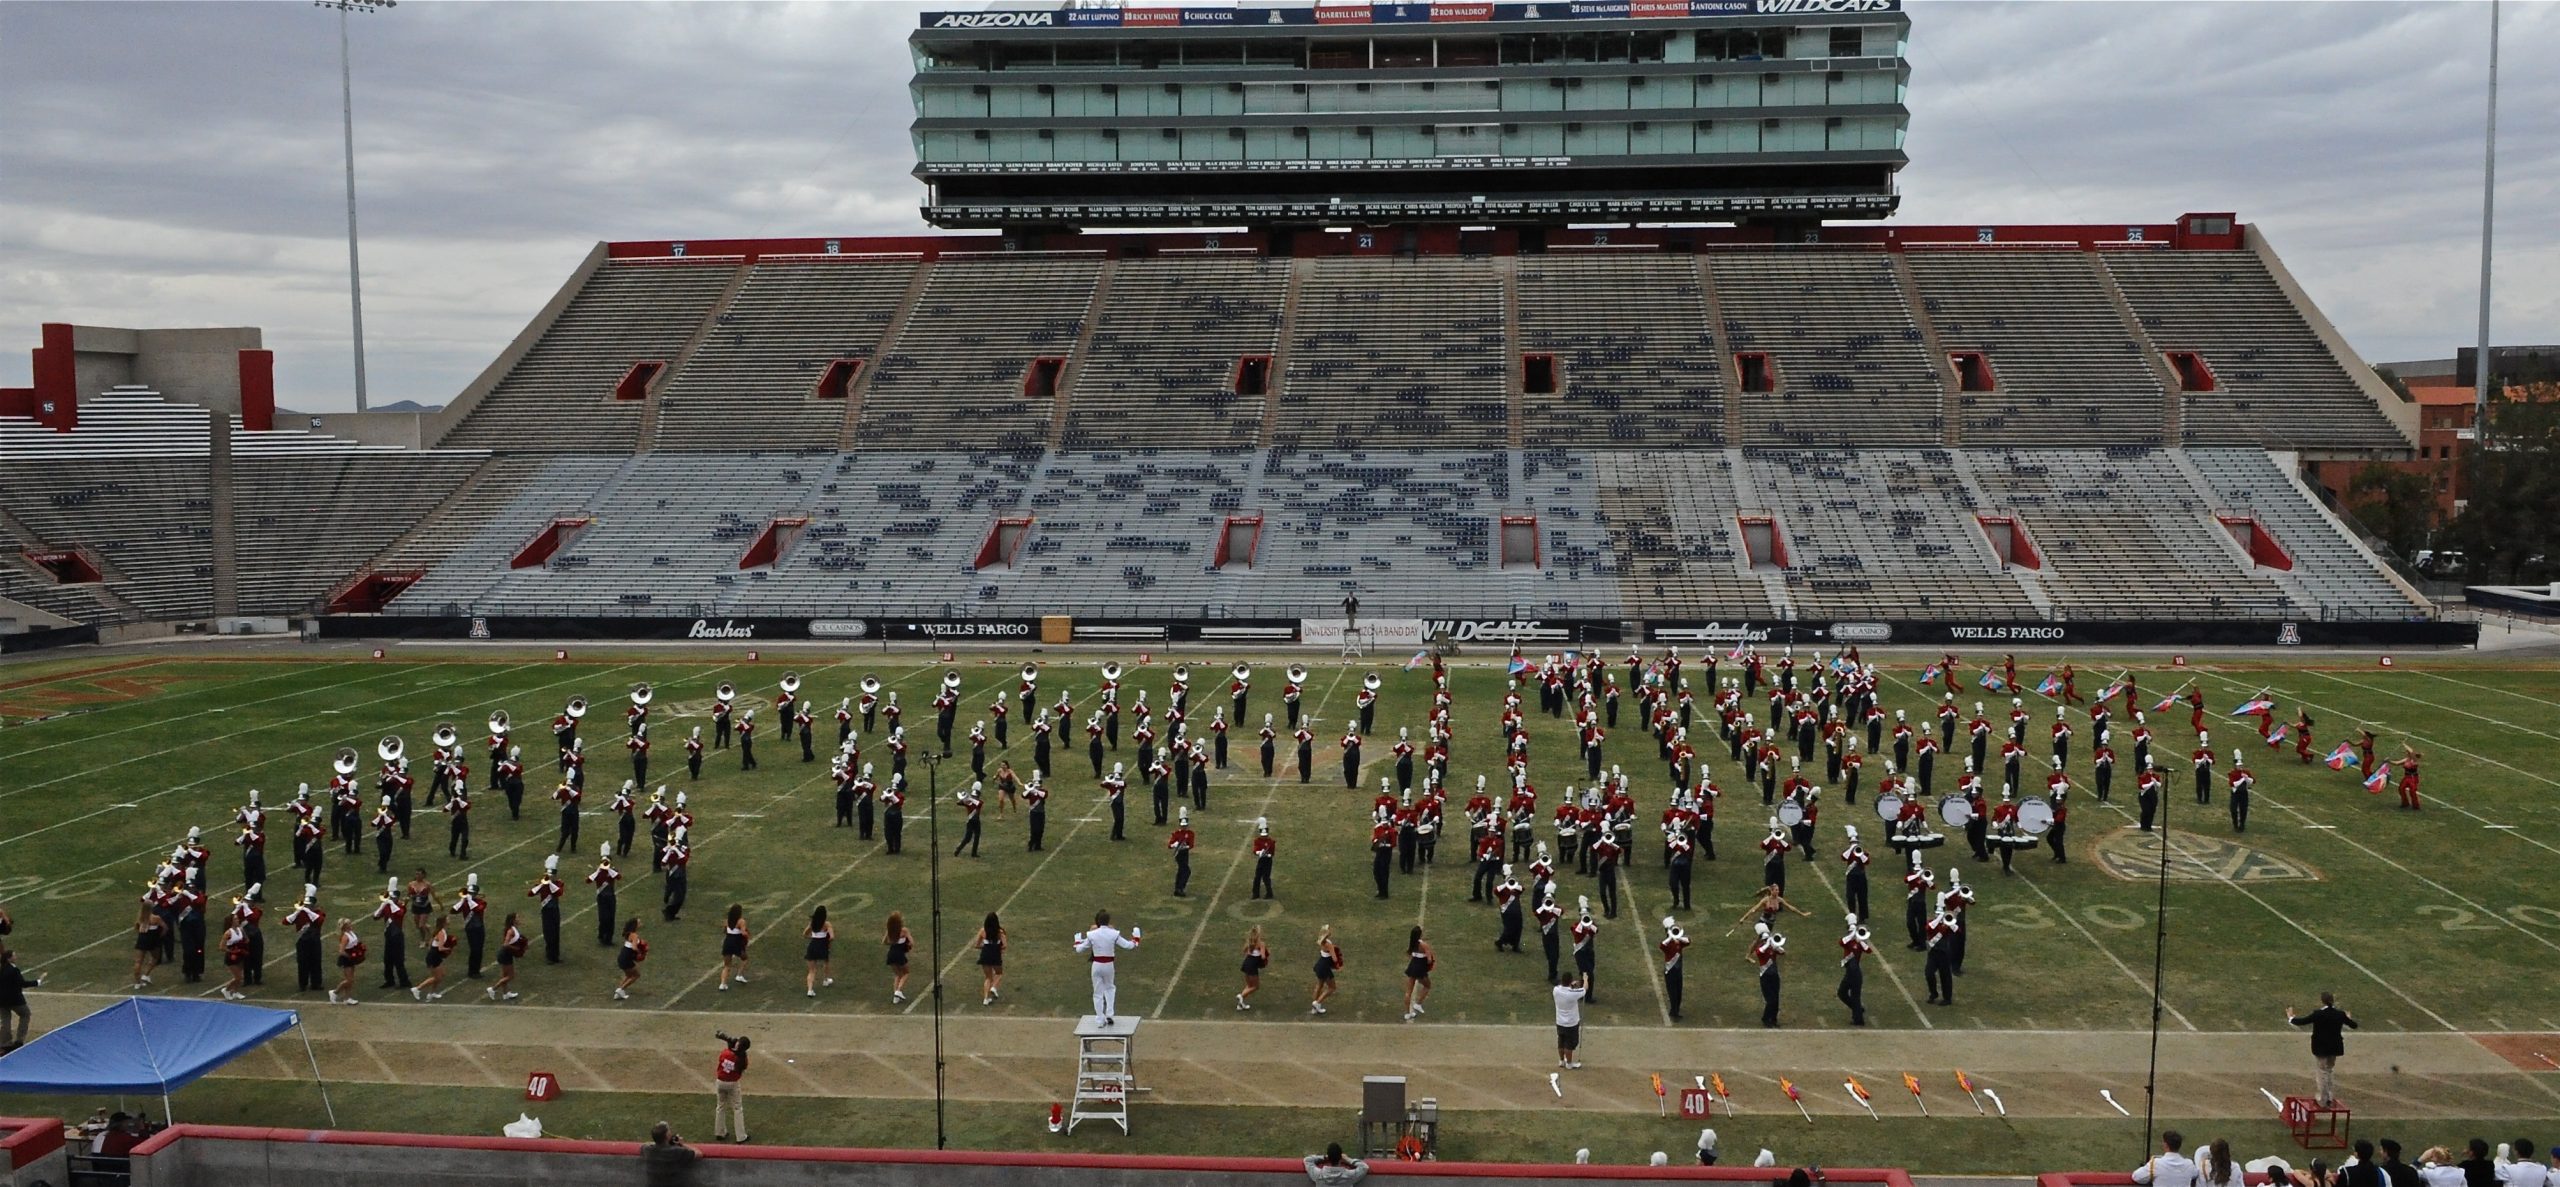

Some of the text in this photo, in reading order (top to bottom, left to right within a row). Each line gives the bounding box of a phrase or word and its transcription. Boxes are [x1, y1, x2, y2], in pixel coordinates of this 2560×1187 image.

[1571, 5, 1580, 13] 28
[1756, 0, 1891, 12] WILDCATS
[1190, 12, 1213, 20] CHUCK
[1351, 10, 1371, 18] LEWIS
[1455, 8, 1487, 16] WALDROP
[934, 13, 1053, 27] ARIZONA
[1068, 13, 1077, 21] 22
[1594, 236, 1607, 245] 22
[1805, 234, 1818, 243] 23
[1979, 233, 1992, 242] 24
[2128, 232, 2142, 242] 25
[1205, 240, 1219, 249] 20
[1360, 238, 1372, 247] 21
[673, 248, 683, 256] 17
[827, 244, 839, 254] 18
[43, 403, 54, 412] 15
[311, 418, 321, 427] 16
[688, 620, 755, 638] Bashas'
[922, 624, 1029, 635] WELLS FARGO
[1304, 627, 1340, 636] UNIVERSITY
[1384, 627, 1404, 637] BAND
[1405, 627, 1419, 637] DAY
[1951, 627, 2065, 639] WELLS FARGO
[528, 1076, 547, 1097] 40
[1103, 1085, 1118, 1102] 50
[1685, 1093, 1704, 1114] 40
